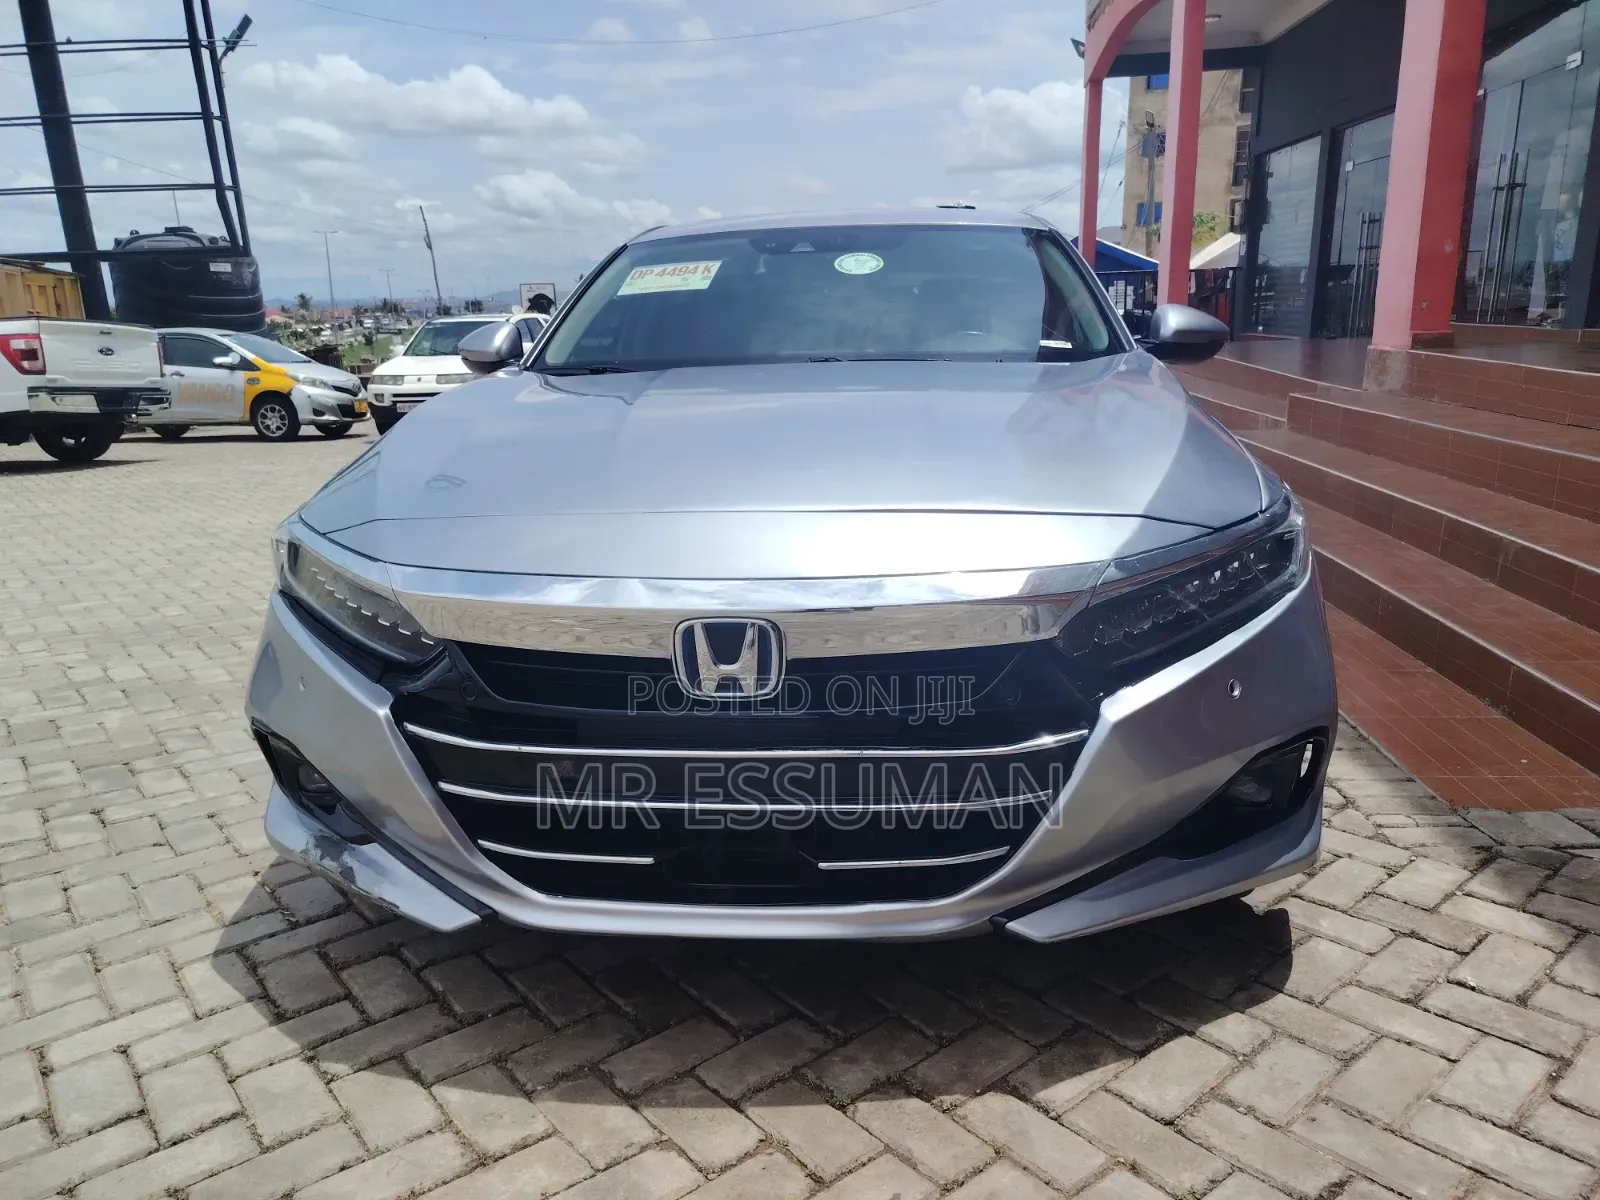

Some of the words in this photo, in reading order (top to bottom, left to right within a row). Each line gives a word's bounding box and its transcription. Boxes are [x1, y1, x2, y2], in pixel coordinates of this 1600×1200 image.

[630, 268, 654, 281] DP
[655, 264, 698, 278] 4494
[700, 263, 716, 275] K
